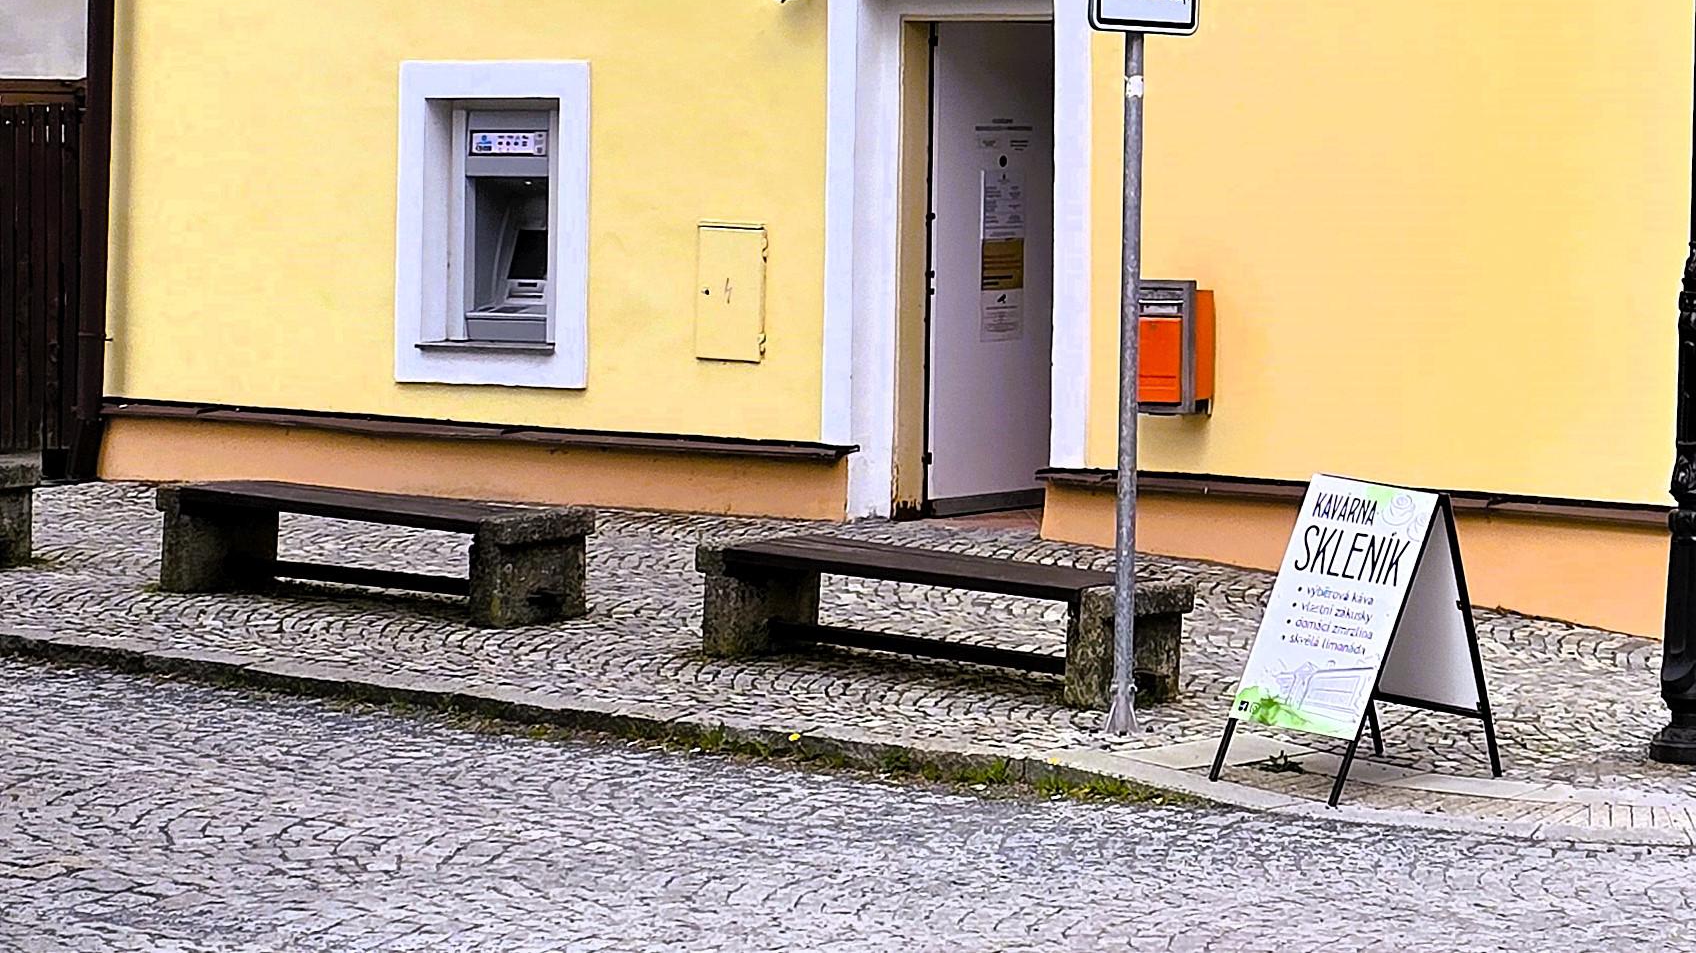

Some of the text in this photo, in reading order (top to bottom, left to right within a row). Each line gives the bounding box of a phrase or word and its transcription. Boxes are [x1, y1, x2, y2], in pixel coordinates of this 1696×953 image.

[1312, 492, 1378, 526] KAVÁRNA
[1294, 525, 1411, 587] SKLENÍK
[1307, 584, 1375, 606] výběrová káva
[1295, 616, 1332, 633] domácí
[1334, 607, 1374, 625] zákusky
